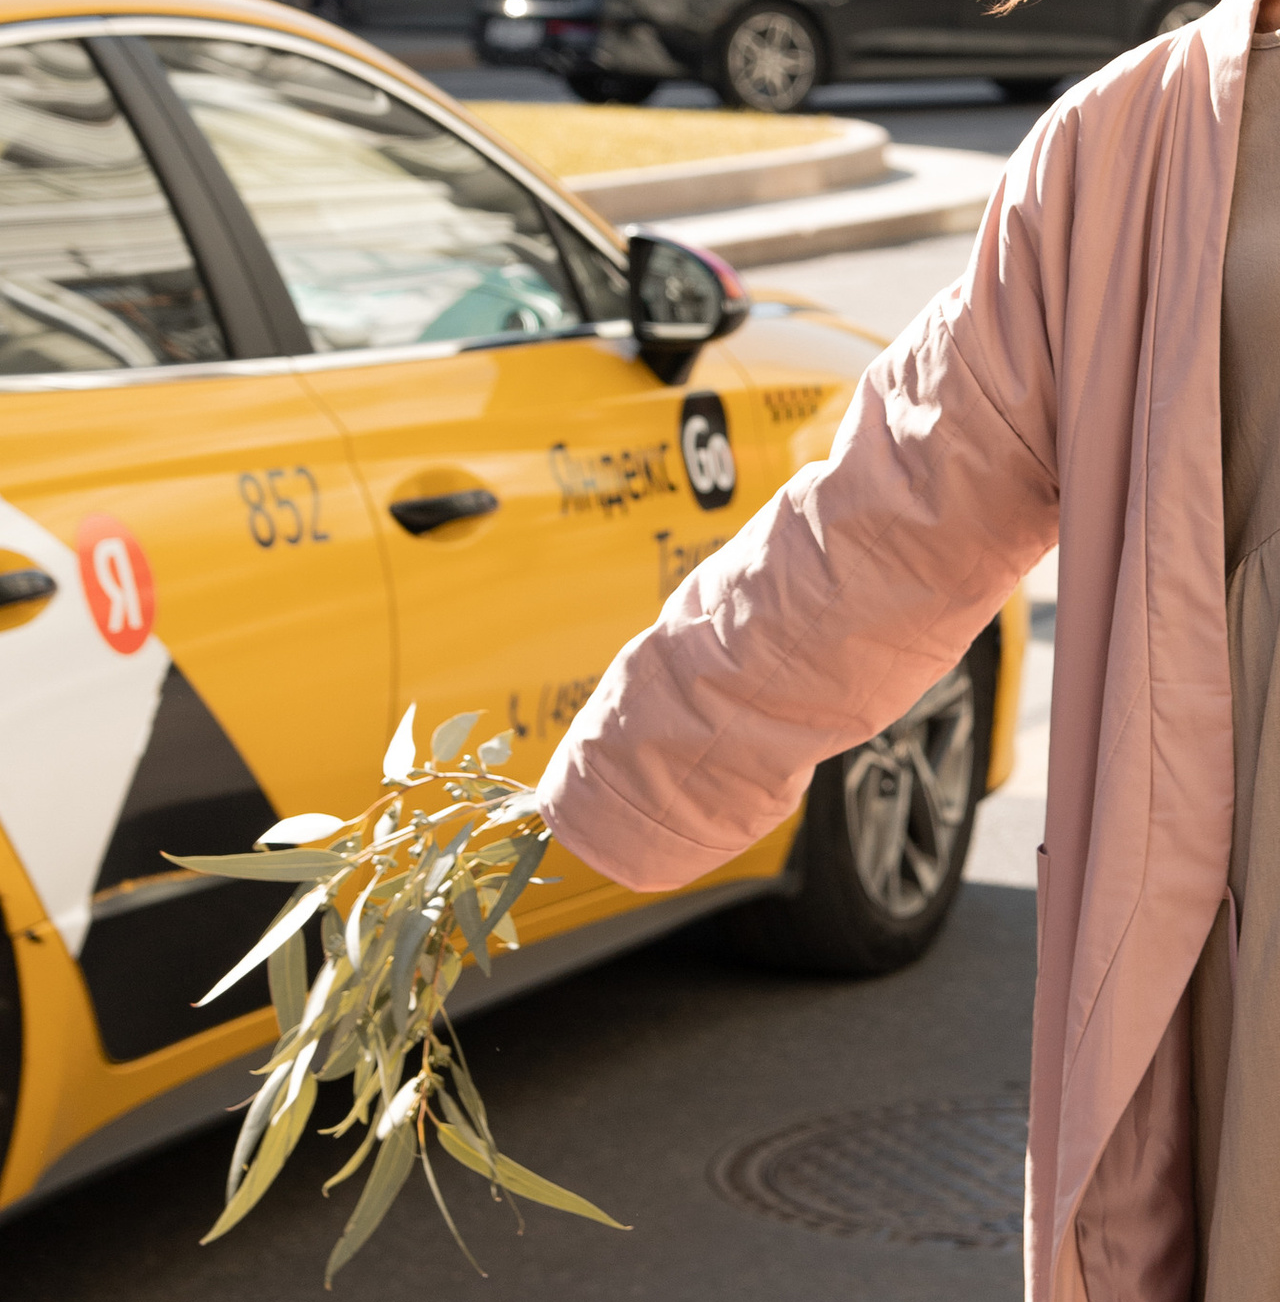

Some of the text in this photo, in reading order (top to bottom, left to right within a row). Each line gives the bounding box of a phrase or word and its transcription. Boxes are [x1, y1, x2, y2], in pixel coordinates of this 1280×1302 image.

[682, 413, 736, 495] Go
[239, 466, 330, 549] 852
[93, 536, 144, 635] Я
